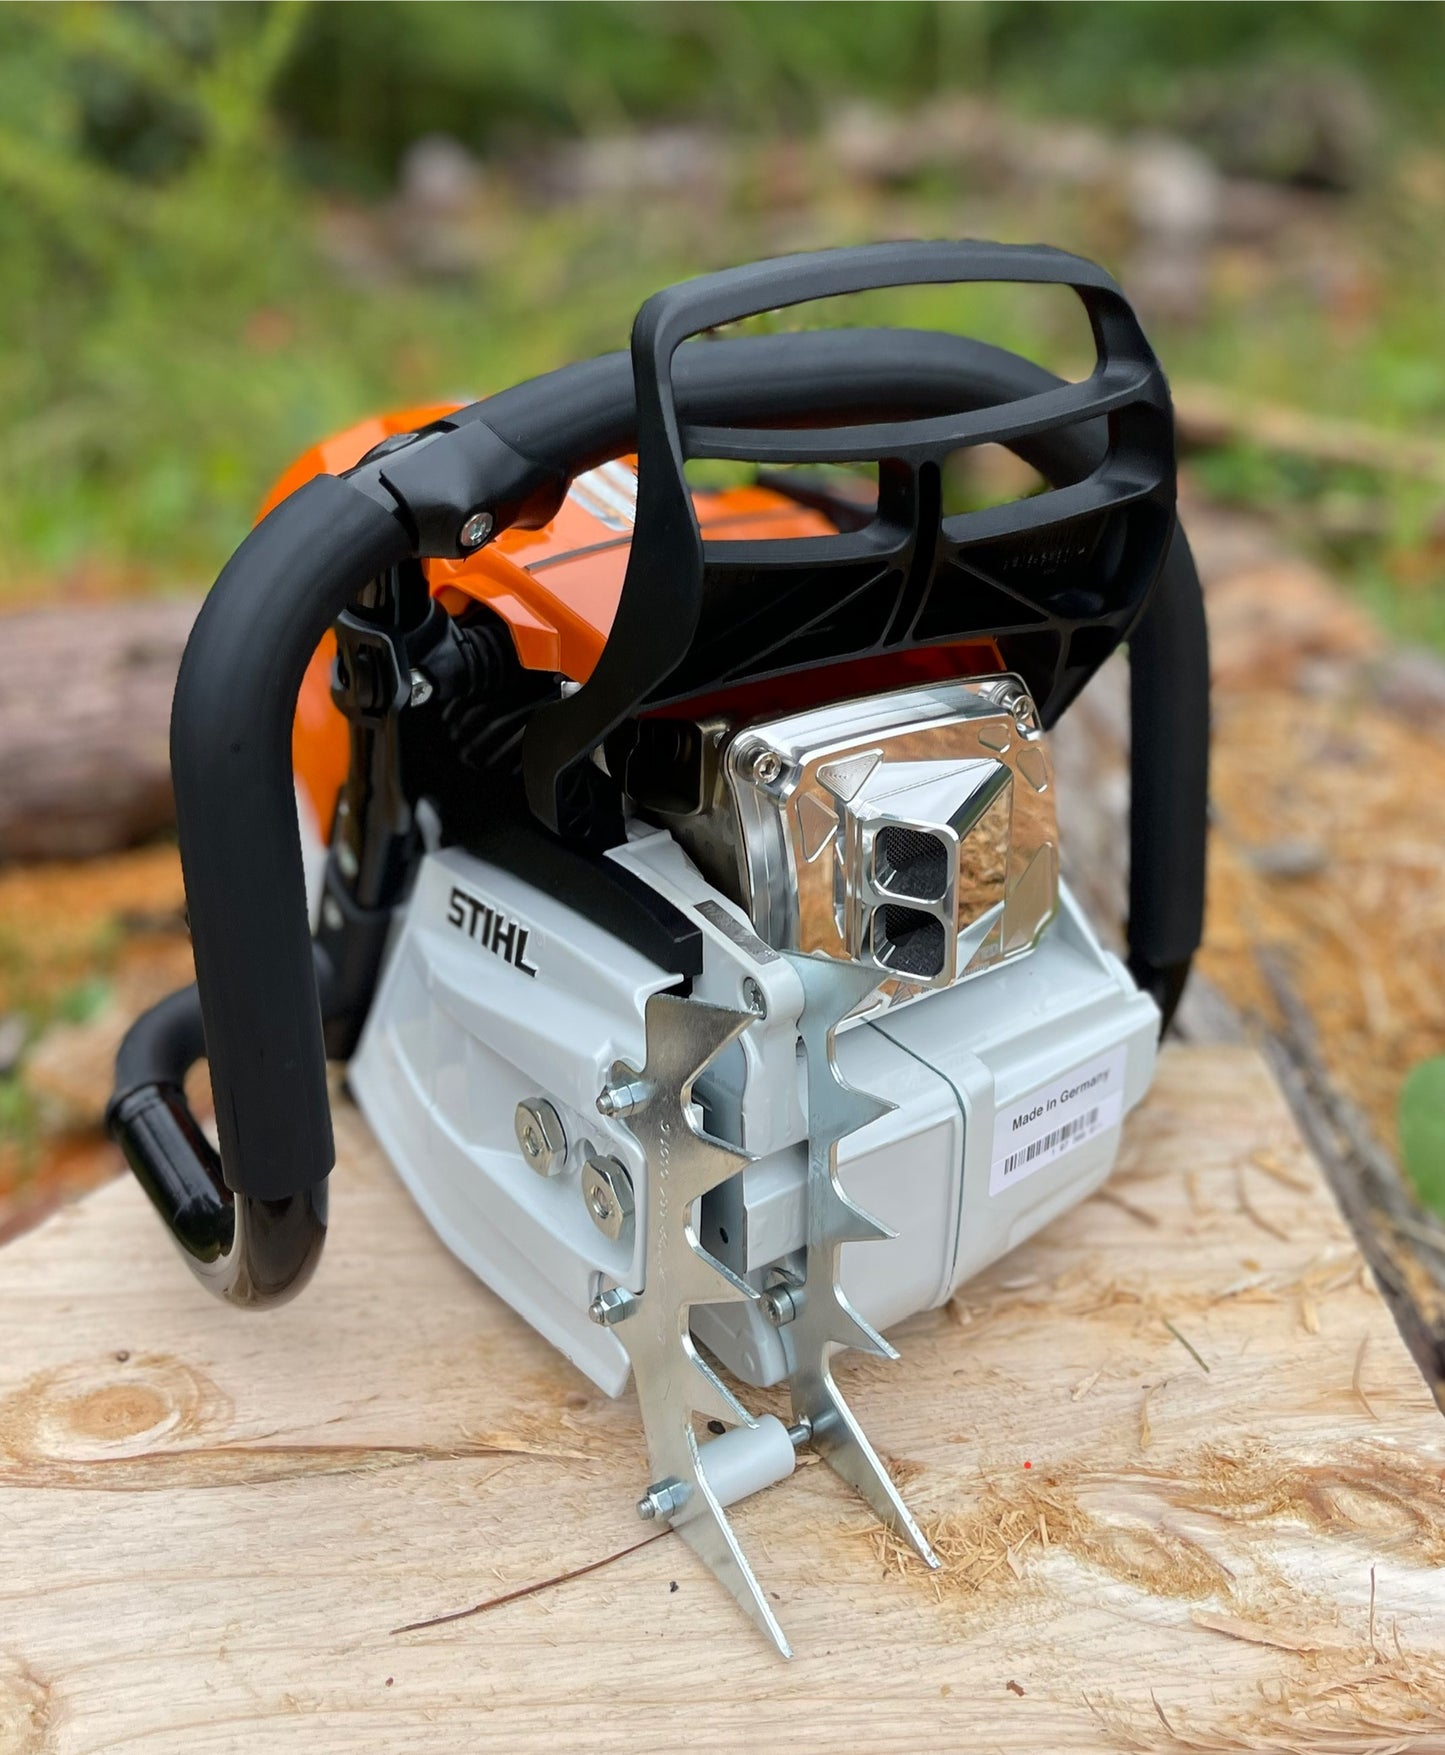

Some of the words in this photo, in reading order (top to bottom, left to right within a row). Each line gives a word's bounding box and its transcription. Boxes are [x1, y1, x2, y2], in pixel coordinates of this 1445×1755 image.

[448, 887, 537, 977] STIHL
[1012, 1106, 1043, 1131] Made
[1046, 1098, 1057, 1112] in
[1060, 1069, 1110, 1102] Germany
